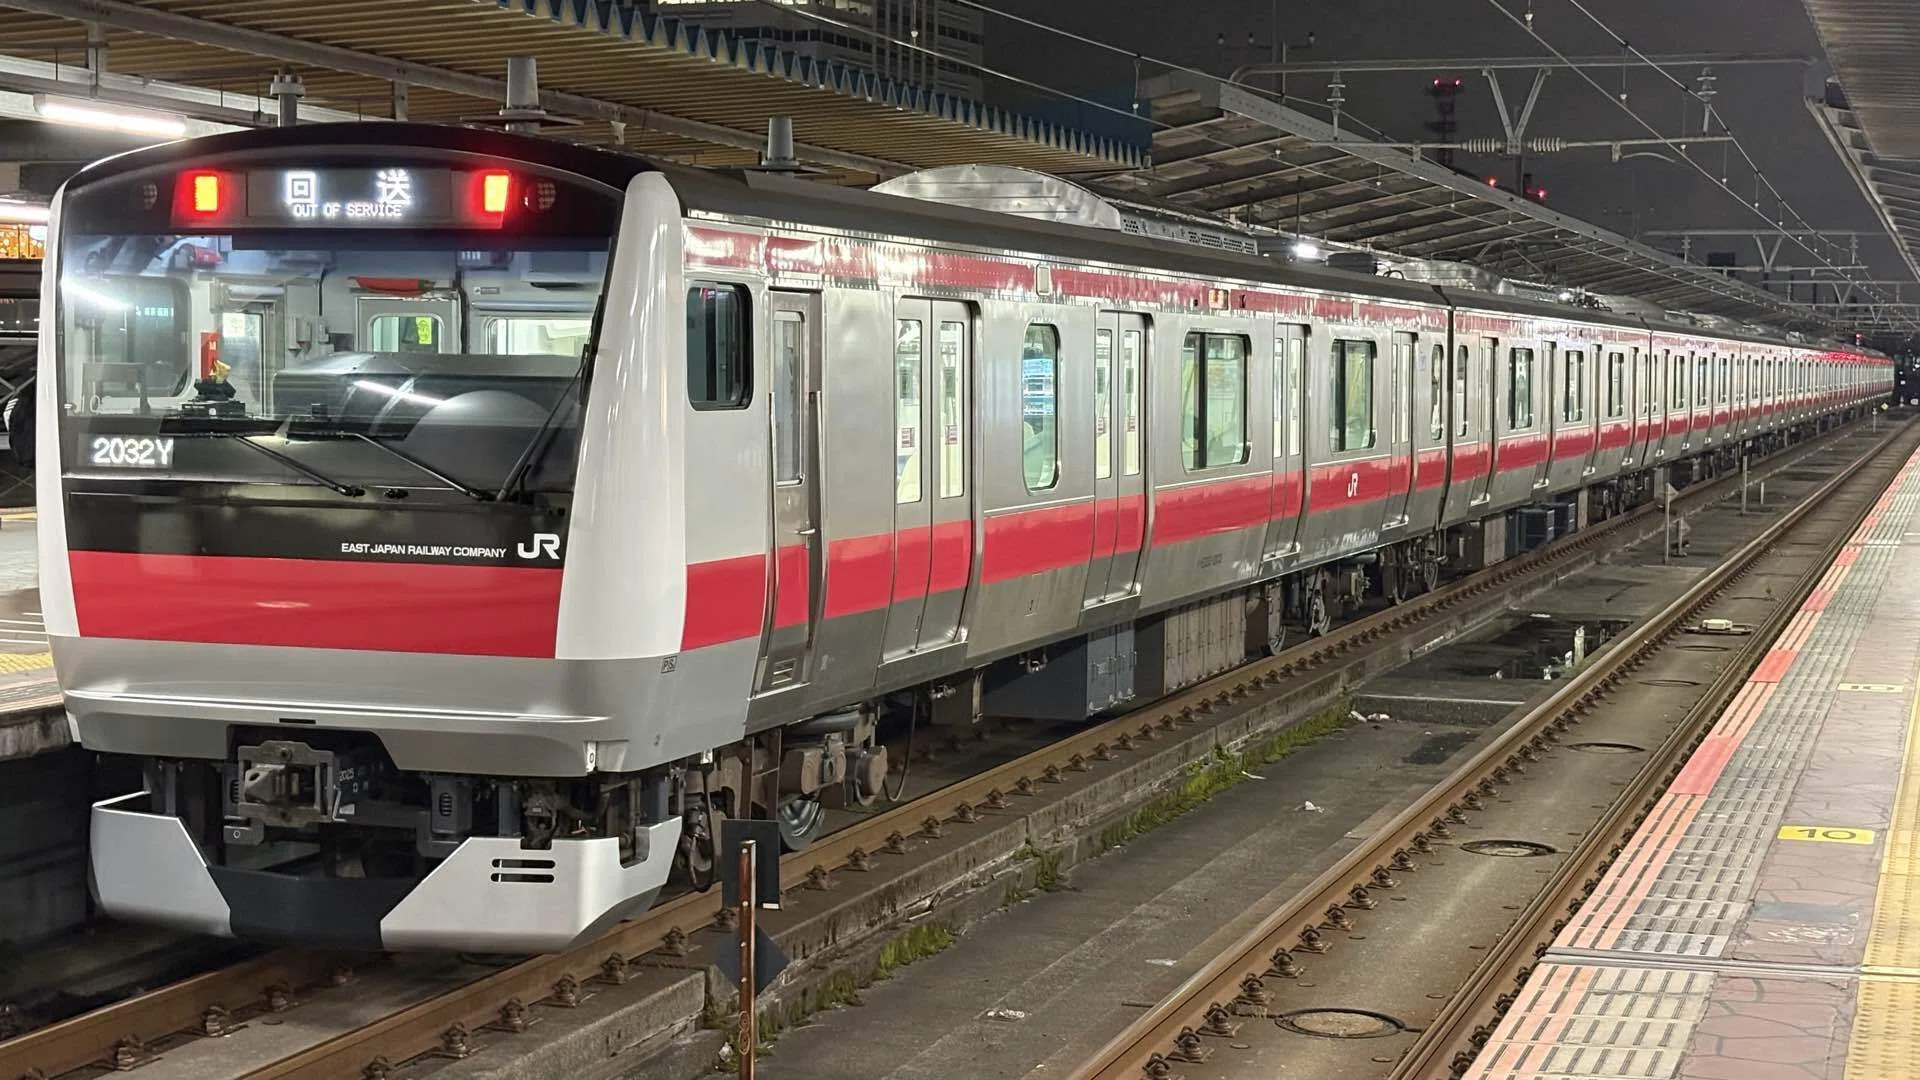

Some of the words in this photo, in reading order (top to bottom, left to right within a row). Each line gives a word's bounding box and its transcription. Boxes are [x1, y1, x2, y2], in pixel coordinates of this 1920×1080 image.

[285, 168, 412, 205] 回送
[294, 203, 316, 217] OUT
[323, 203, 340, 217] OF
[345, 203, 403, 217] SERVICE
[93, 437, 174, 465] 2032Y
[1347, 472, 1358, 498] JR
[341, 543, 370, 553] EAST
[370, 544, 406, 555] JAPAN
[407, 545, 452, 556] RAILWAY
[453, 547, 507, 558] COMPANY
[517, 533, 560, 560] JR
[1797, 828, 1857, 840] 10
